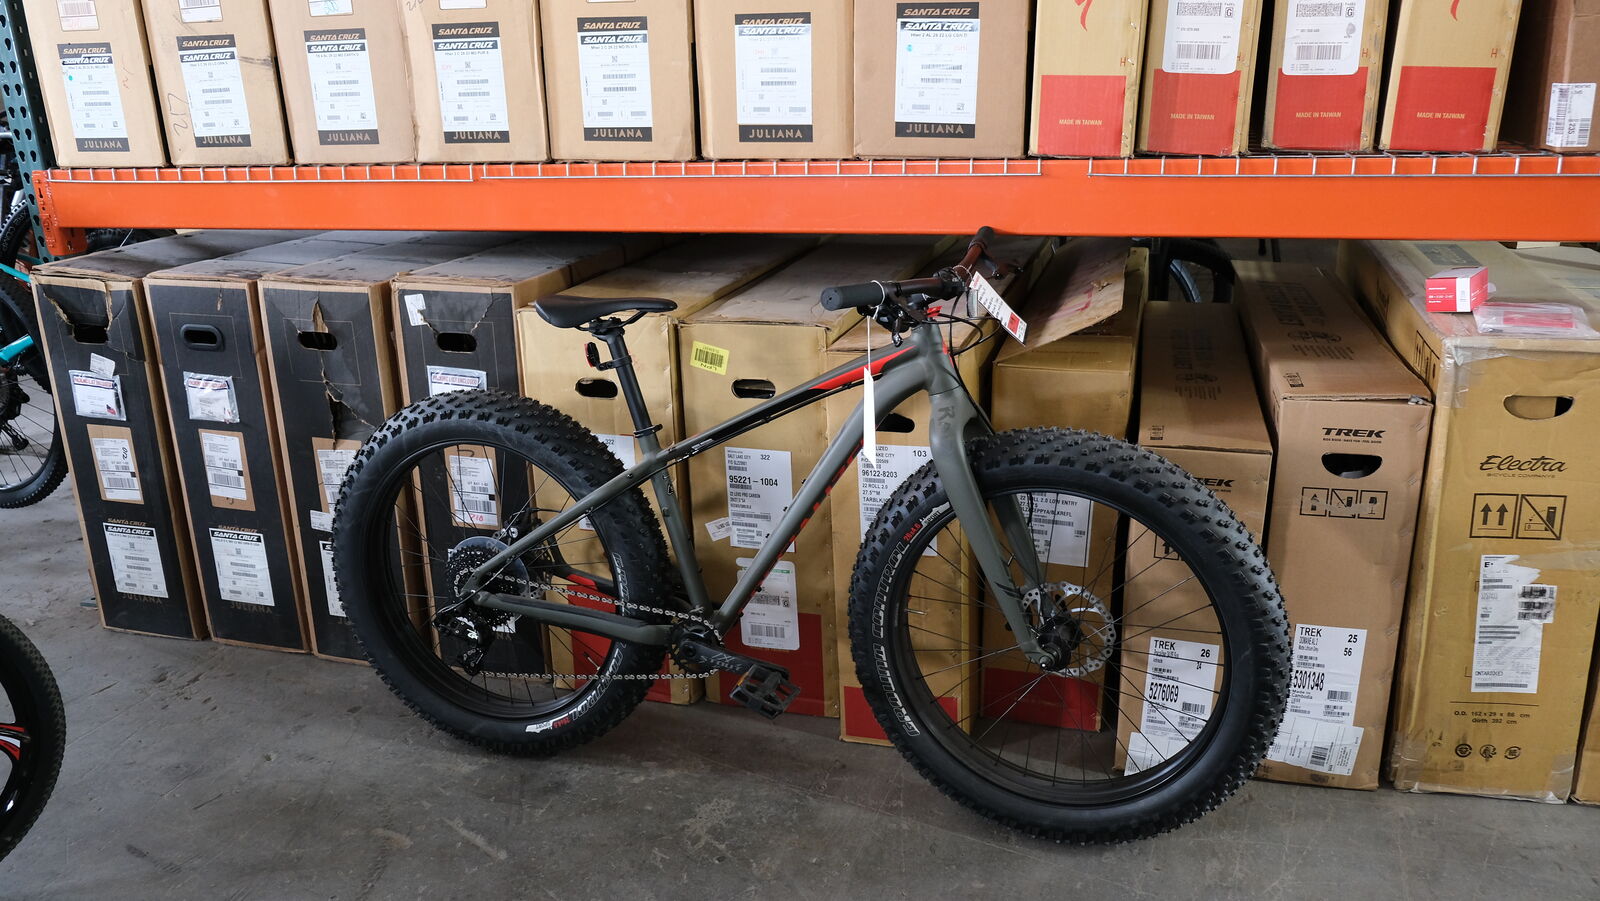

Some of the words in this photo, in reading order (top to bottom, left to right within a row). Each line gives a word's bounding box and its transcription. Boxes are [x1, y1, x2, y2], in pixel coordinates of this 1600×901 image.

[903, 22, 941, 31] SANTA
[941, 22, 973, 31] CRUZ
[1491, 48, 1498, 58] H
[1120, 57, 1126, 66] H
[593, 129, 643, 137] JULIANA
[749, 129, 802, 138] JULIANA
[906, 124, 964, 133] JULIANA
[202, 136, 243, 144] JULIANA
[328, 132, 370, 142] JULIANA
[453, 131, 500, 139] JULIANA
[84, 140, 122, 149] JULIANA
[1322, 427, 1386, 438] TREK
[1480, 455, 1568, 472] Electra
[862, 470, 898, 478] 96122-8203
[107, 526, 131, 534] SANTA
[872, 540, 910, 638] CONTROL
[1300, 627, 1322, 637] TREK
[1348, 634, 1358, 644] 25
[1154, 640, 1176, 650] TREK
[1201, 649, 1210, 658] 26
[1344, 647, 1352, 657] 56
[1293, 670, 1325, 692] 5301348
[874, 643, 920, 737] GROUND
[1148, 682, 1179, 703] 5276069
